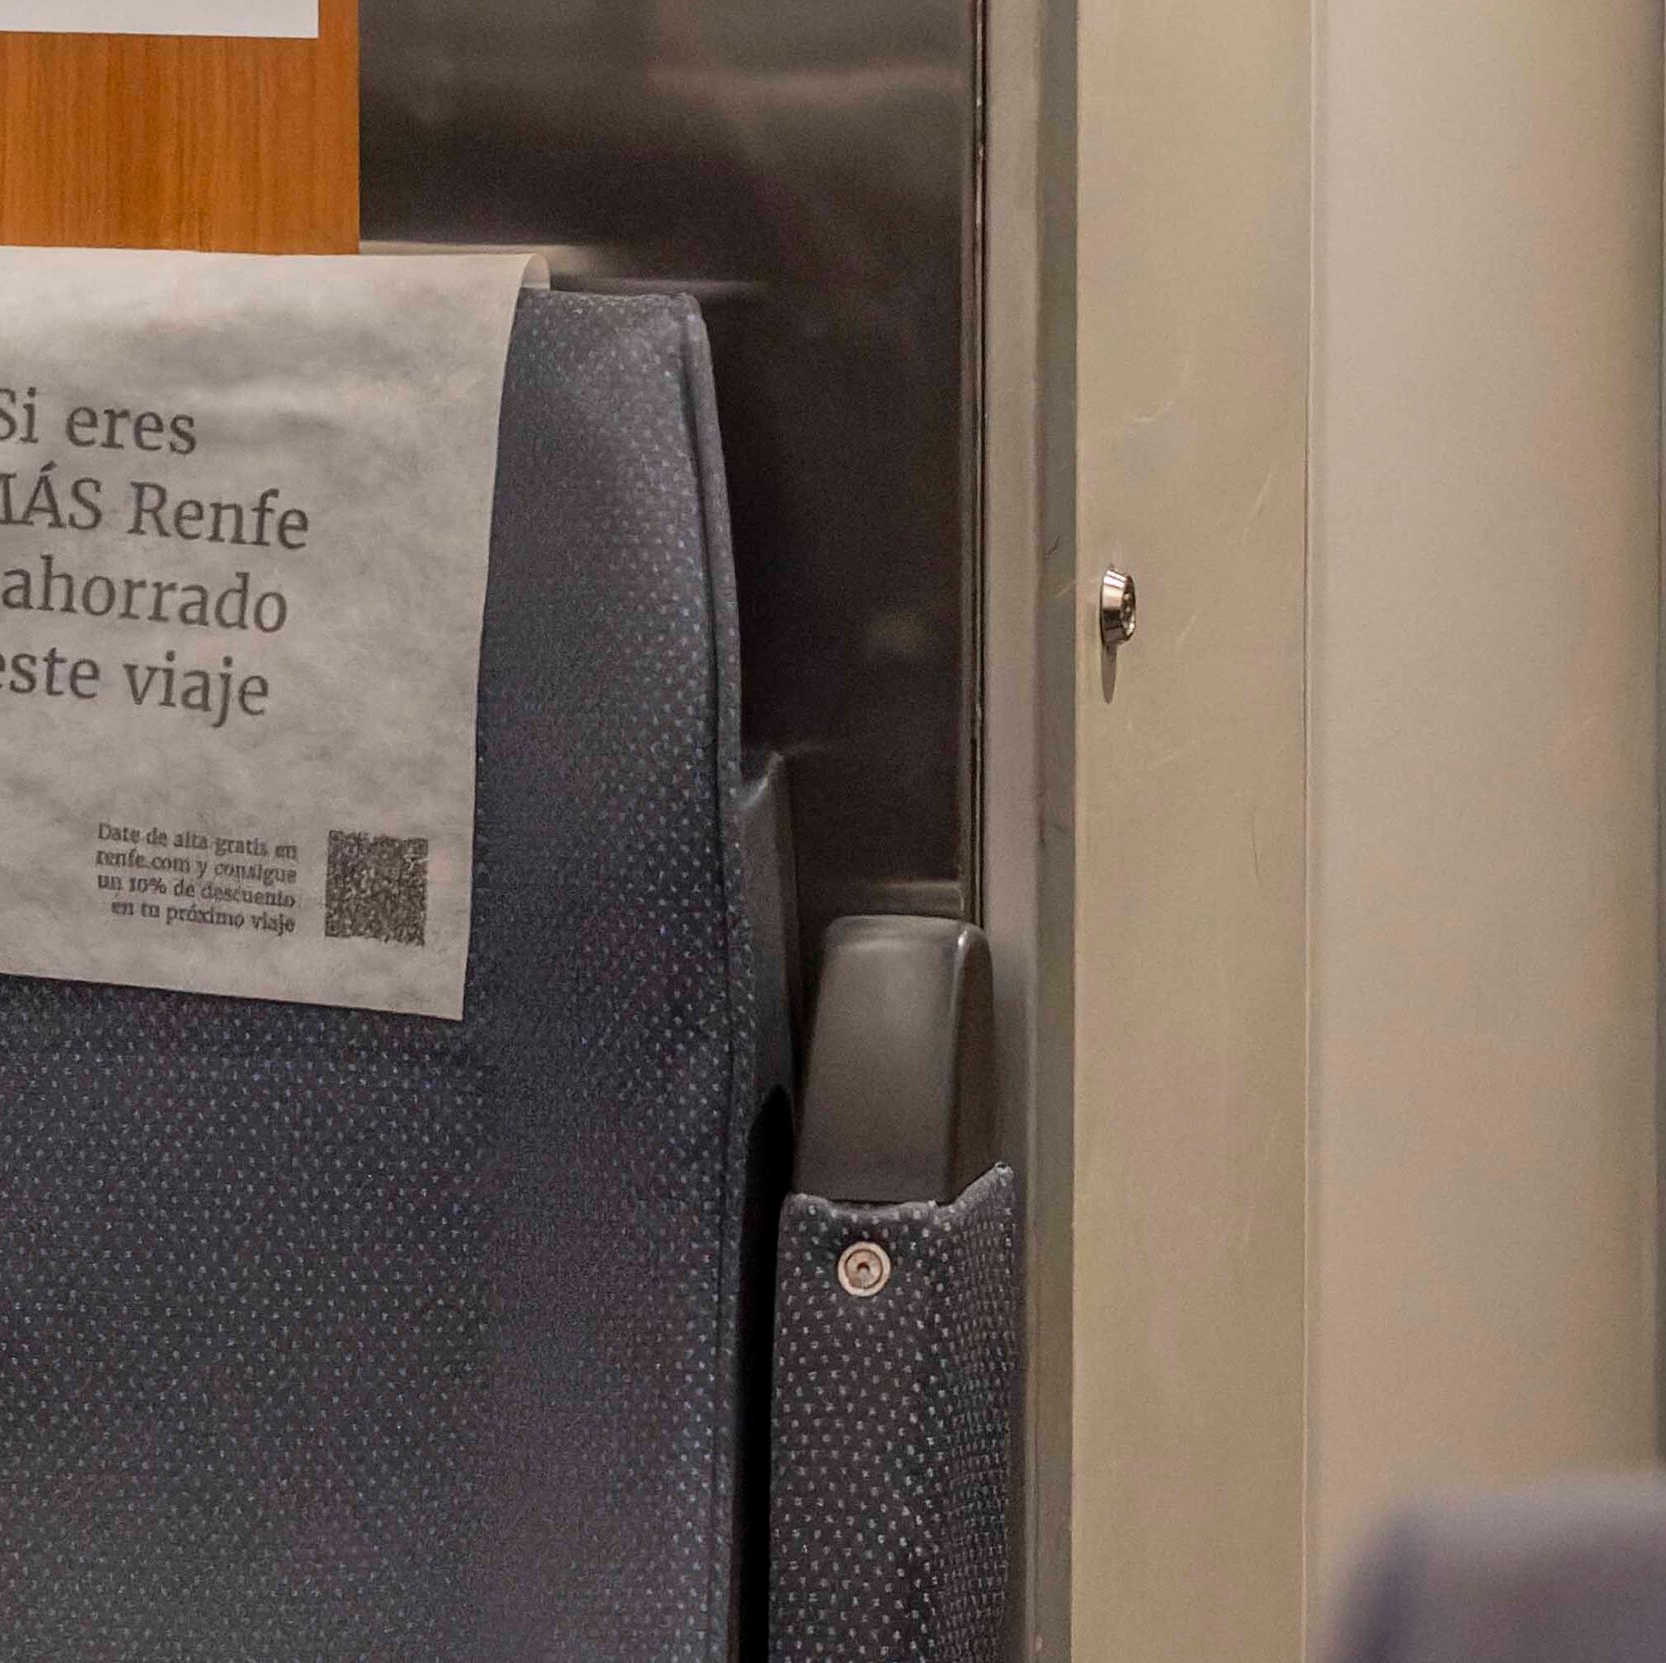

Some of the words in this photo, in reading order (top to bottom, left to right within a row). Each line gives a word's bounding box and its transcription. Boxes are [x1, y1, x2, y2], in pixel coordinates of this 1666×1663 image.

[65, 405, 197, 456] eres
[126, 481, 310, 551] Renfe
[0, 553, 287, 633] ahorrado
[122, 649, 269, 730] viaje
[97, 822, 140, 845] Date
[146, 826, 168, 848] de
[173, 831, 208, 850] alta
[214, 837, 268, 857] gratis
[274, 844, 298, 861] en
[97, 873, 123, 891] un
[173, 879, 195, 898] de
[200, 883, 296, 908] descuento
[197, 860, 208, 879] y
[213, 863, 298, 886] consigue
[111, 900, 134, 916] en
[140, 900, 160, 918] tu
[166, 903, 245, 928] próximo
[250, 912, 297, 936] viaje
